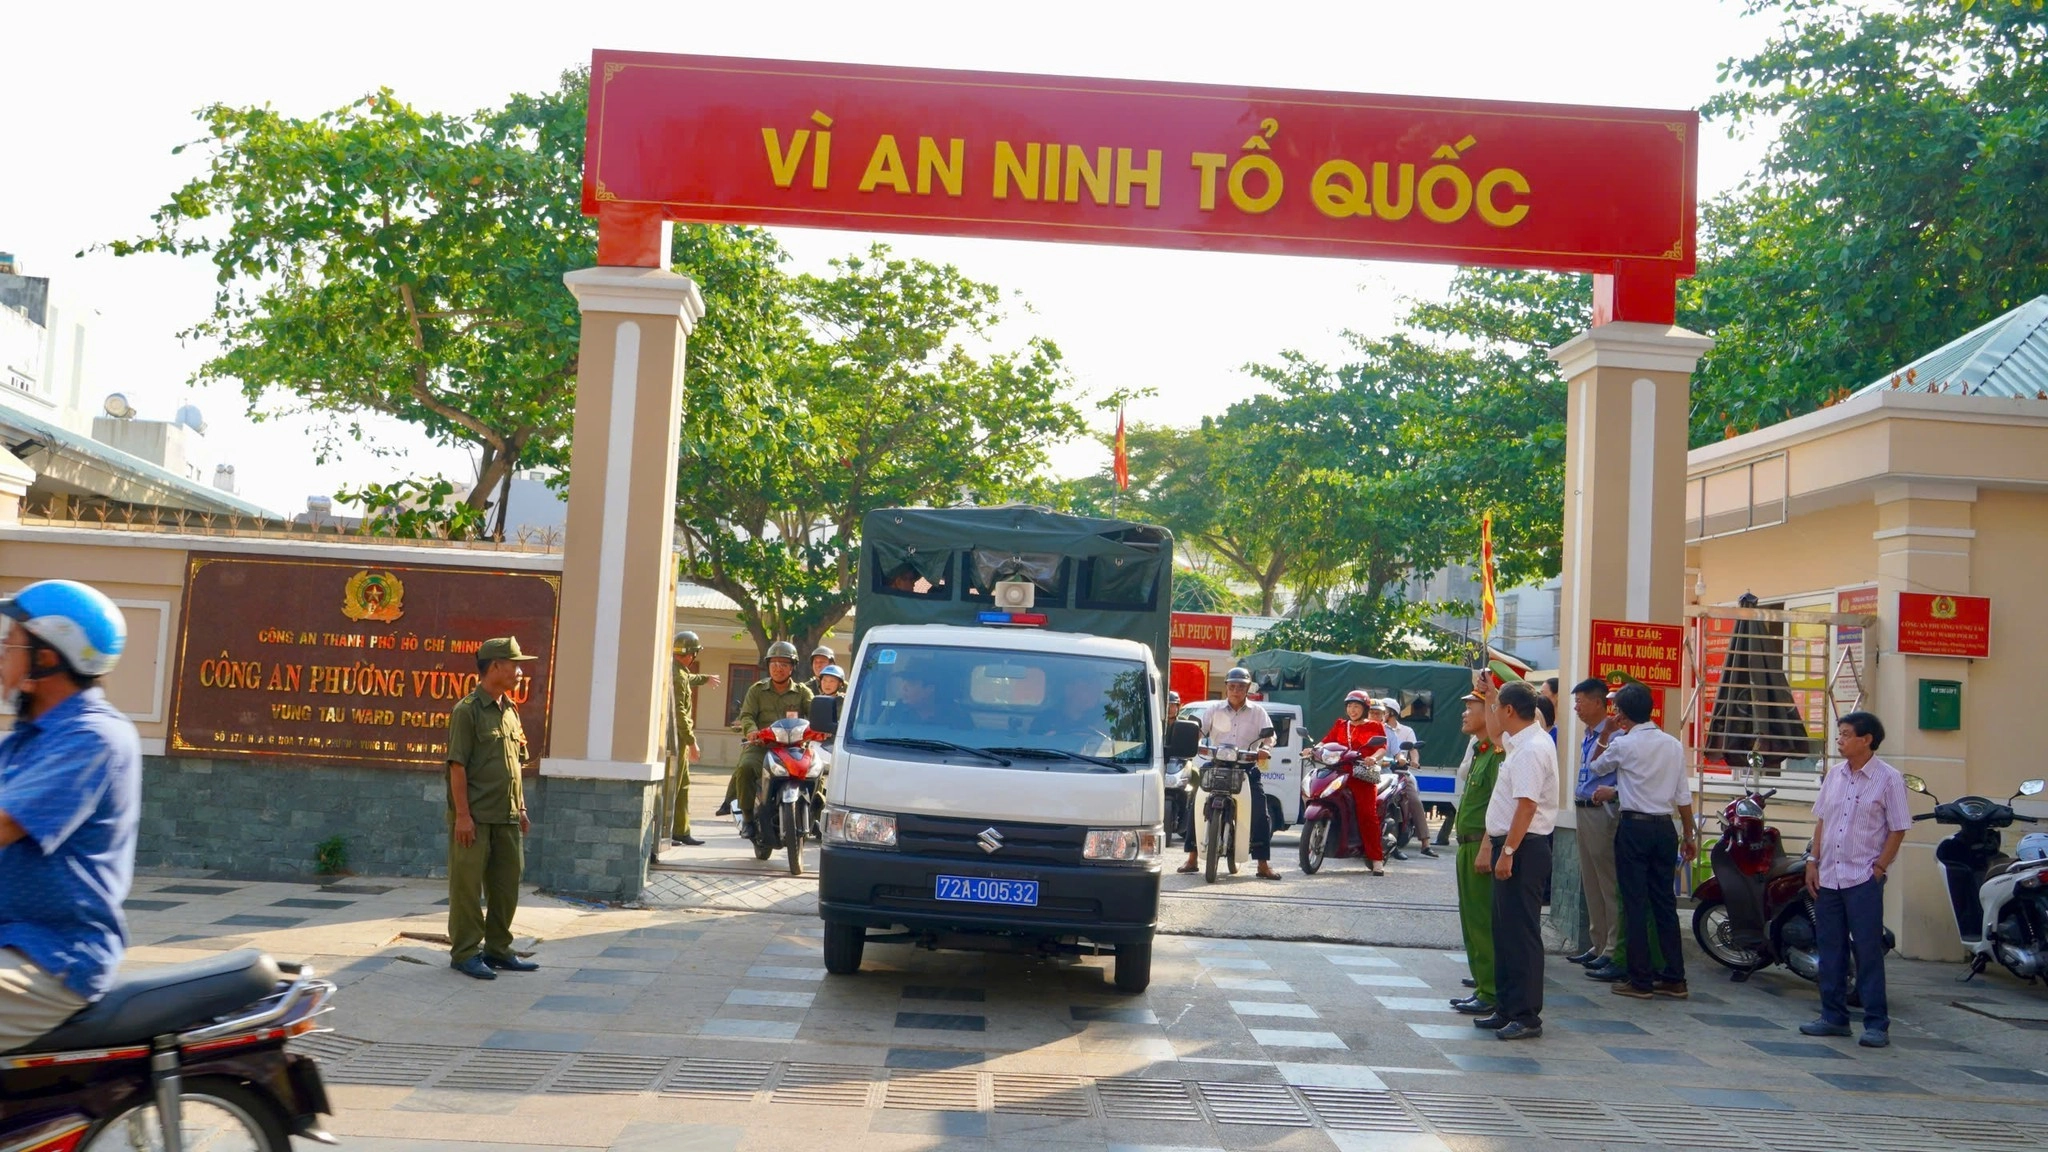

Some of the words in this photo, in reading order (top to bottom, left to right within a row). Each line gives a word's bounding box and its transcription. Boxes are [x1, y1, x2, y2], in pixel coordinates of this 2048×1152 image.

[761, 109, 833, 189] VÌ
[858, 134, 965, 196] AN
[993, 140, 1163, 208] NINH
[1191, 117, 1284, 214] TỔ
[1310, 134, 1530, 227] QUỐC
[258, 626, 295, 645] CÔNG
[299, 631, 318, 646] AN
[369, 630, 398, 650] PHỐ
[400, 631, 419, 651] HỒ
[423, 634, 446, 652] CHÍ
[1187, 623, 1212, 644] PHỤC
[1214, 625, 1228, 645] VỤ
[1613, 626, 1634, 638] YÊU
[1613, 641, 1634, 659] MÁY,
[1635, 641, 1665, 660] XUỐNG
[1666, 647, 1677, 660] XE
[200, 650, 262, 690] CÔNG
[266, 662, 302, 692] AN
[308, 658, 405, 698] PHƯỜNG
[1630, 662, 1647, 679] VÀO
[271, 703, 312, 721] VUNG
[318, 706, 346, 723] TAU
[351, 708, 395, 726] WARD
[939, 877, 1036, 903] 72A-005.32
